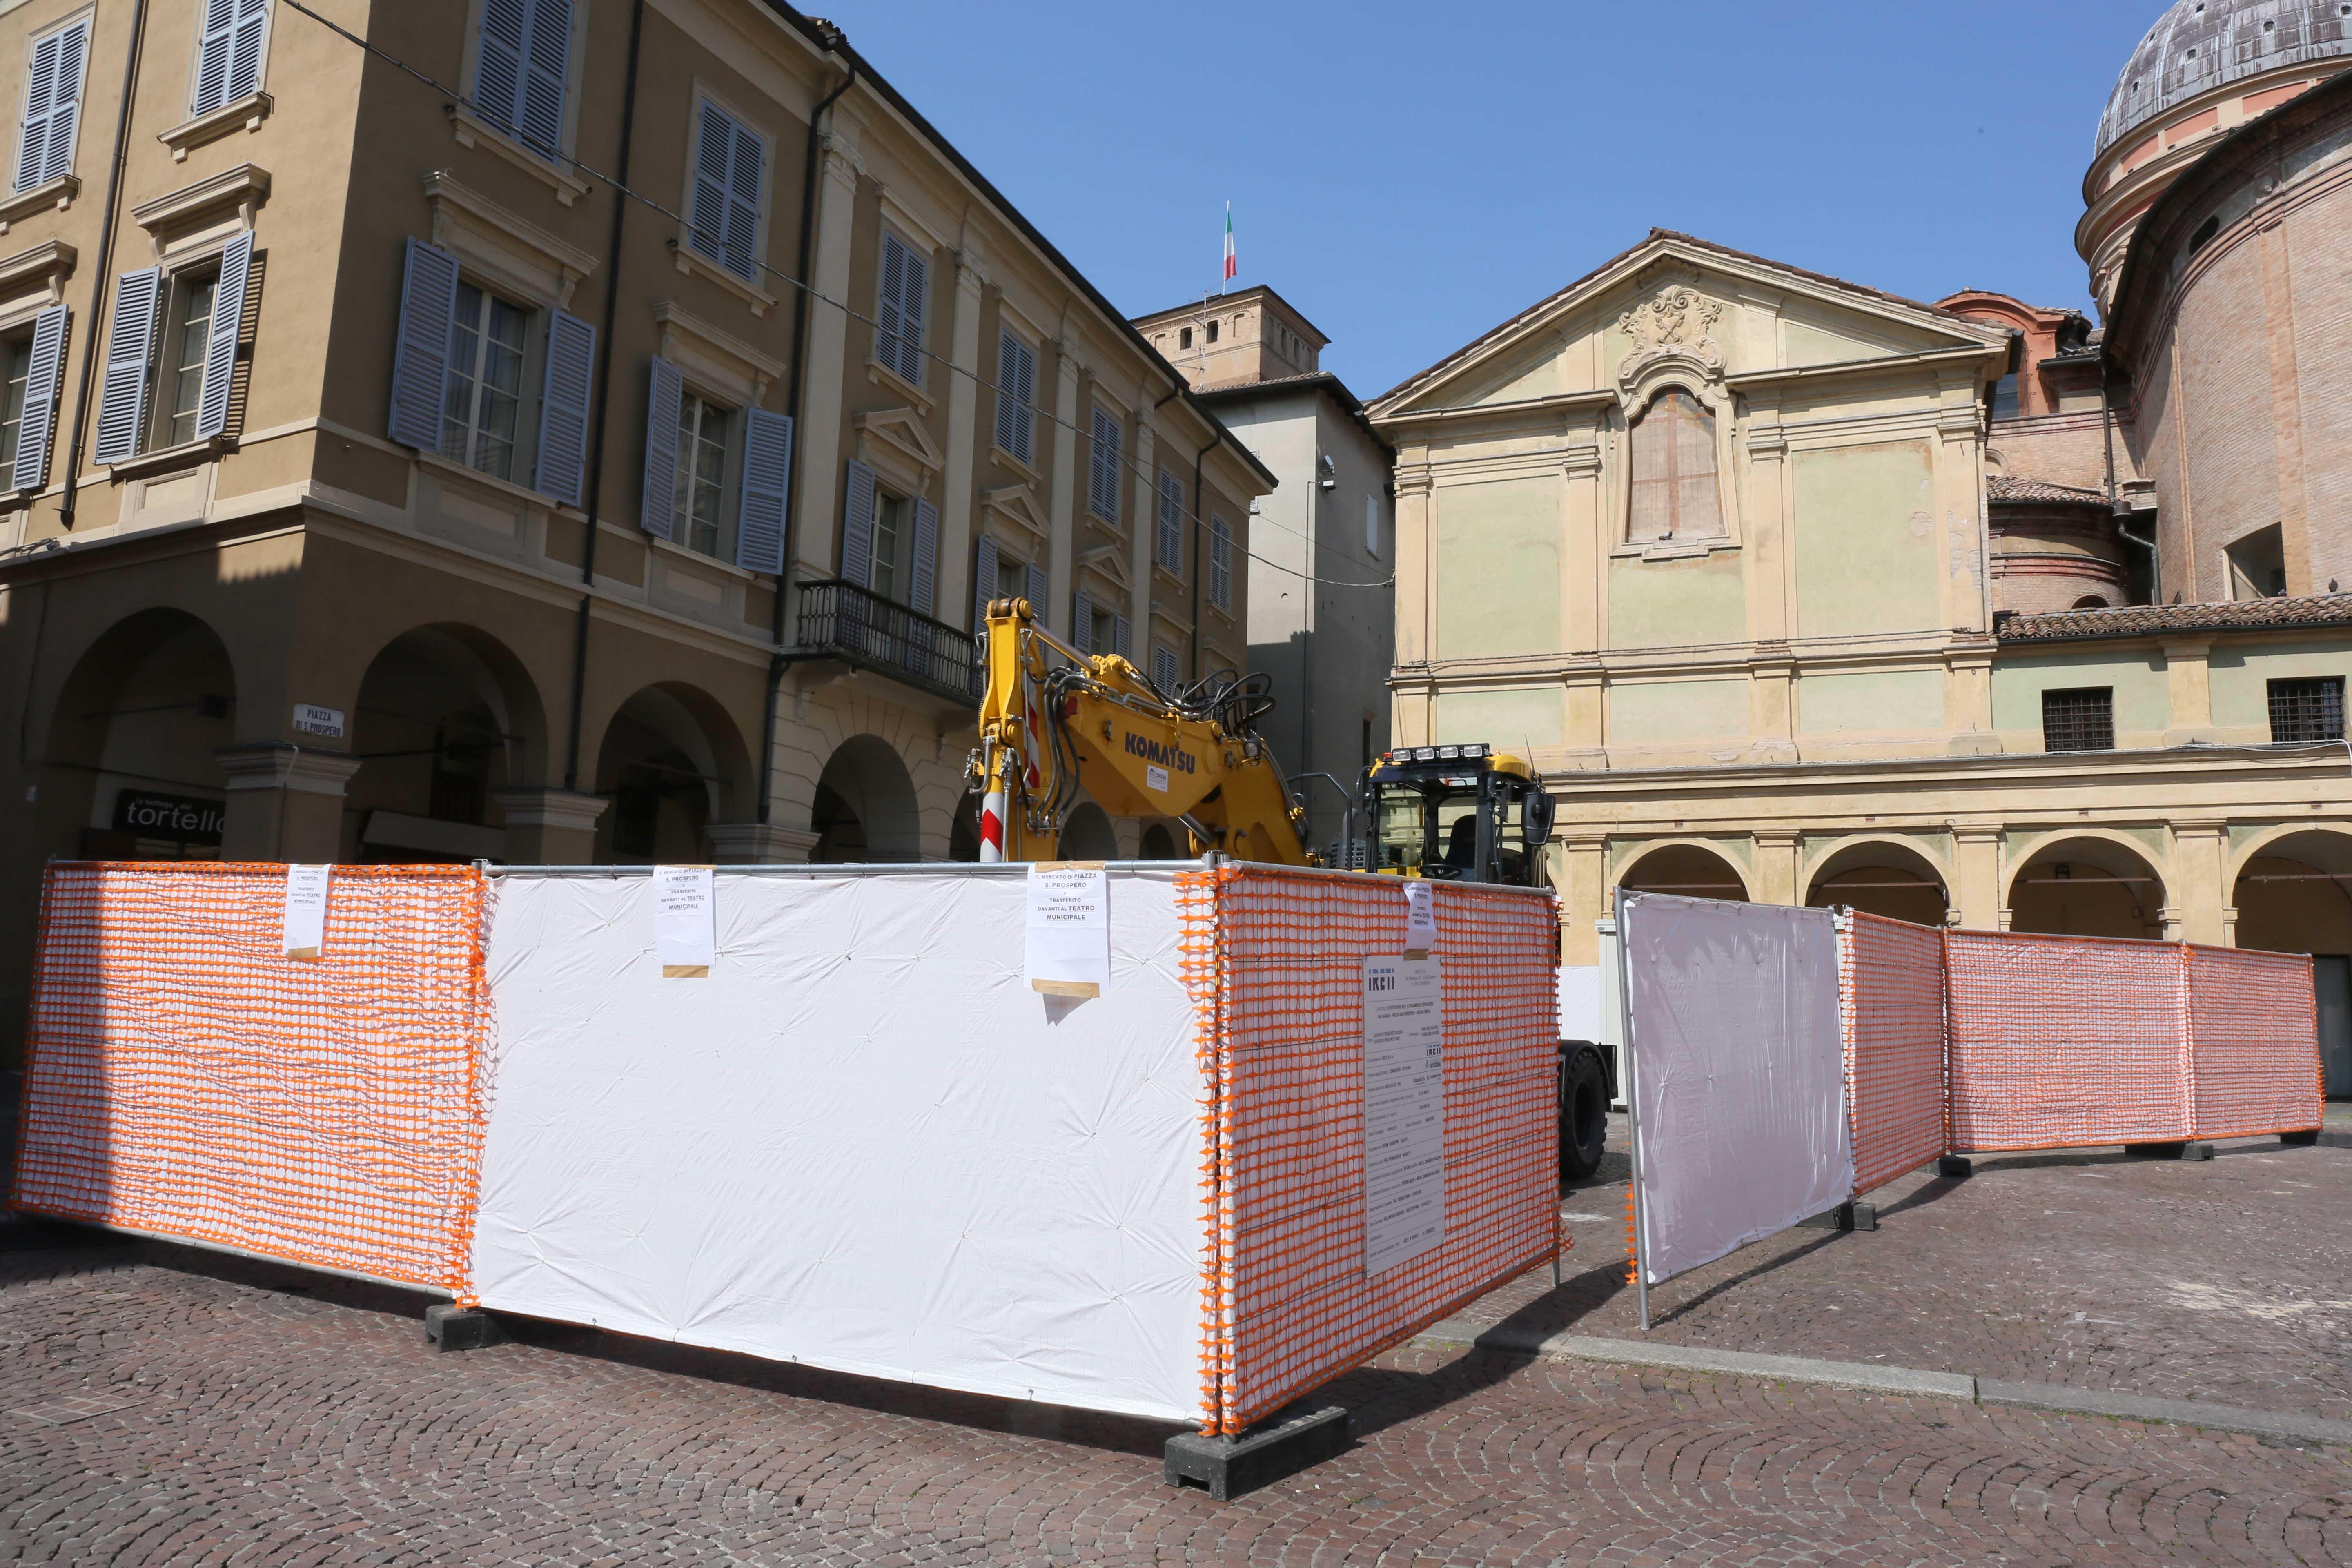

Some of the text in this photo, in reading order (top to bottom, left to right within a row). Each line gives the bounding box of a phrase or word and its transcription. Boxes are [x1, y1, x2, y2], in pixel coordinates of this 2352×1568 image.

[307, 709, 331, 722] PIAZZA
[296, 720, 302, 729] DI
[310, 722, 341, 736] PROSPERO
[1125, 731, 1195, 774] KOMATSU
[145, 799, 174, 808] bottega
